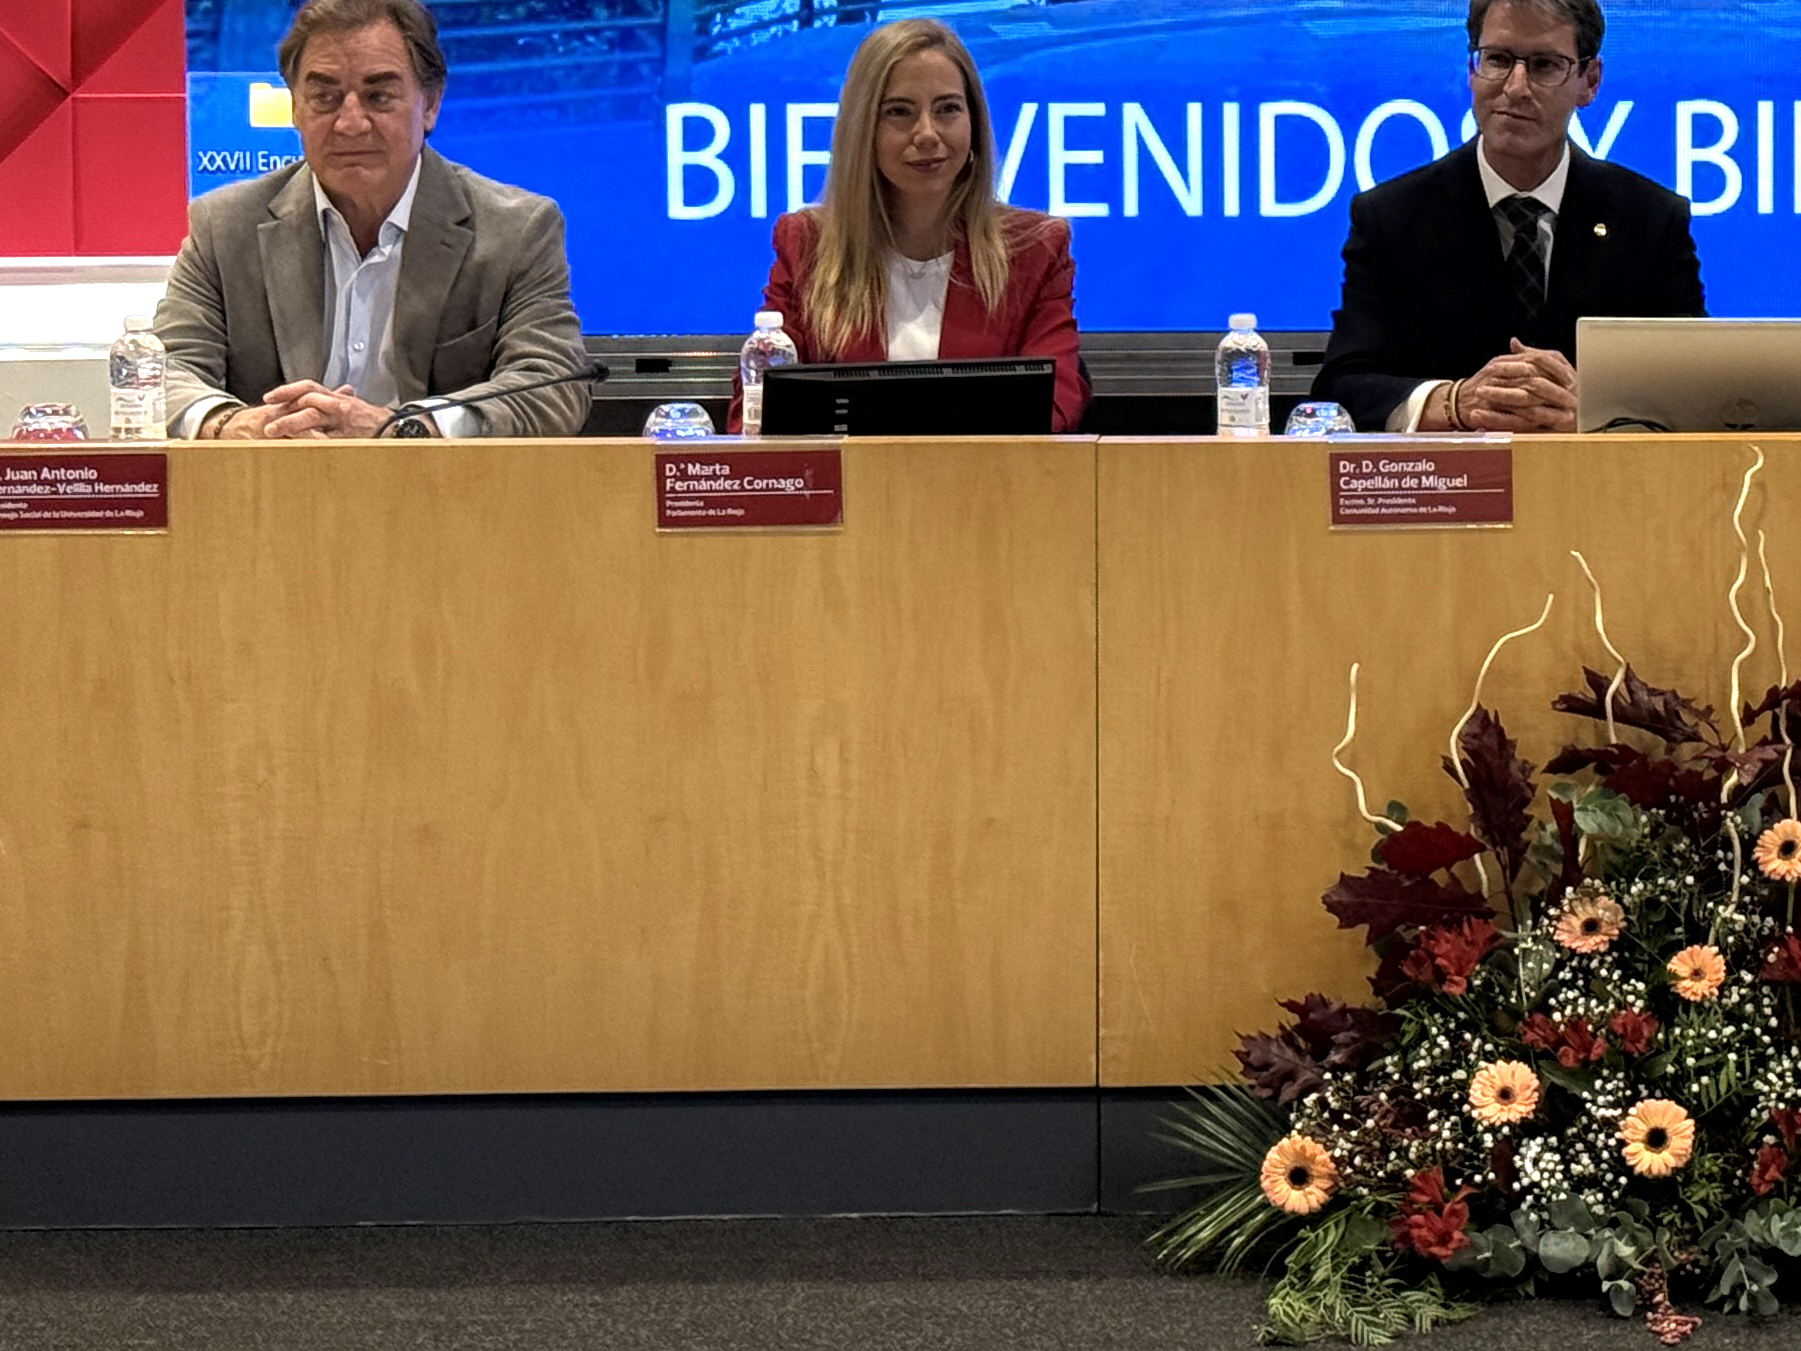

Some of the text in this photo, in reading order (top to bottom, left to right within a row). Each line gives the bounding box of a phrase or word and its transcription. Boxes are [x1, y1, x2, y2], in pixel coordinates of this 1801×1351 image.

[198, 151, 304, 171] XXVII Enc
[666, 99, 1478, 216] BIEENIDO
[4, 466, 98, 481] Juan Antonio
[687, 463, 730, 476] Marta
[1339, 459, 1435, 473] Dr. D. Gonzalo
[94, 481, 159, 493] Hernández
[665, 476, 804, 491] Fernández Cornago
[1339, 473, 1468, 492] Capellán de Miguel
